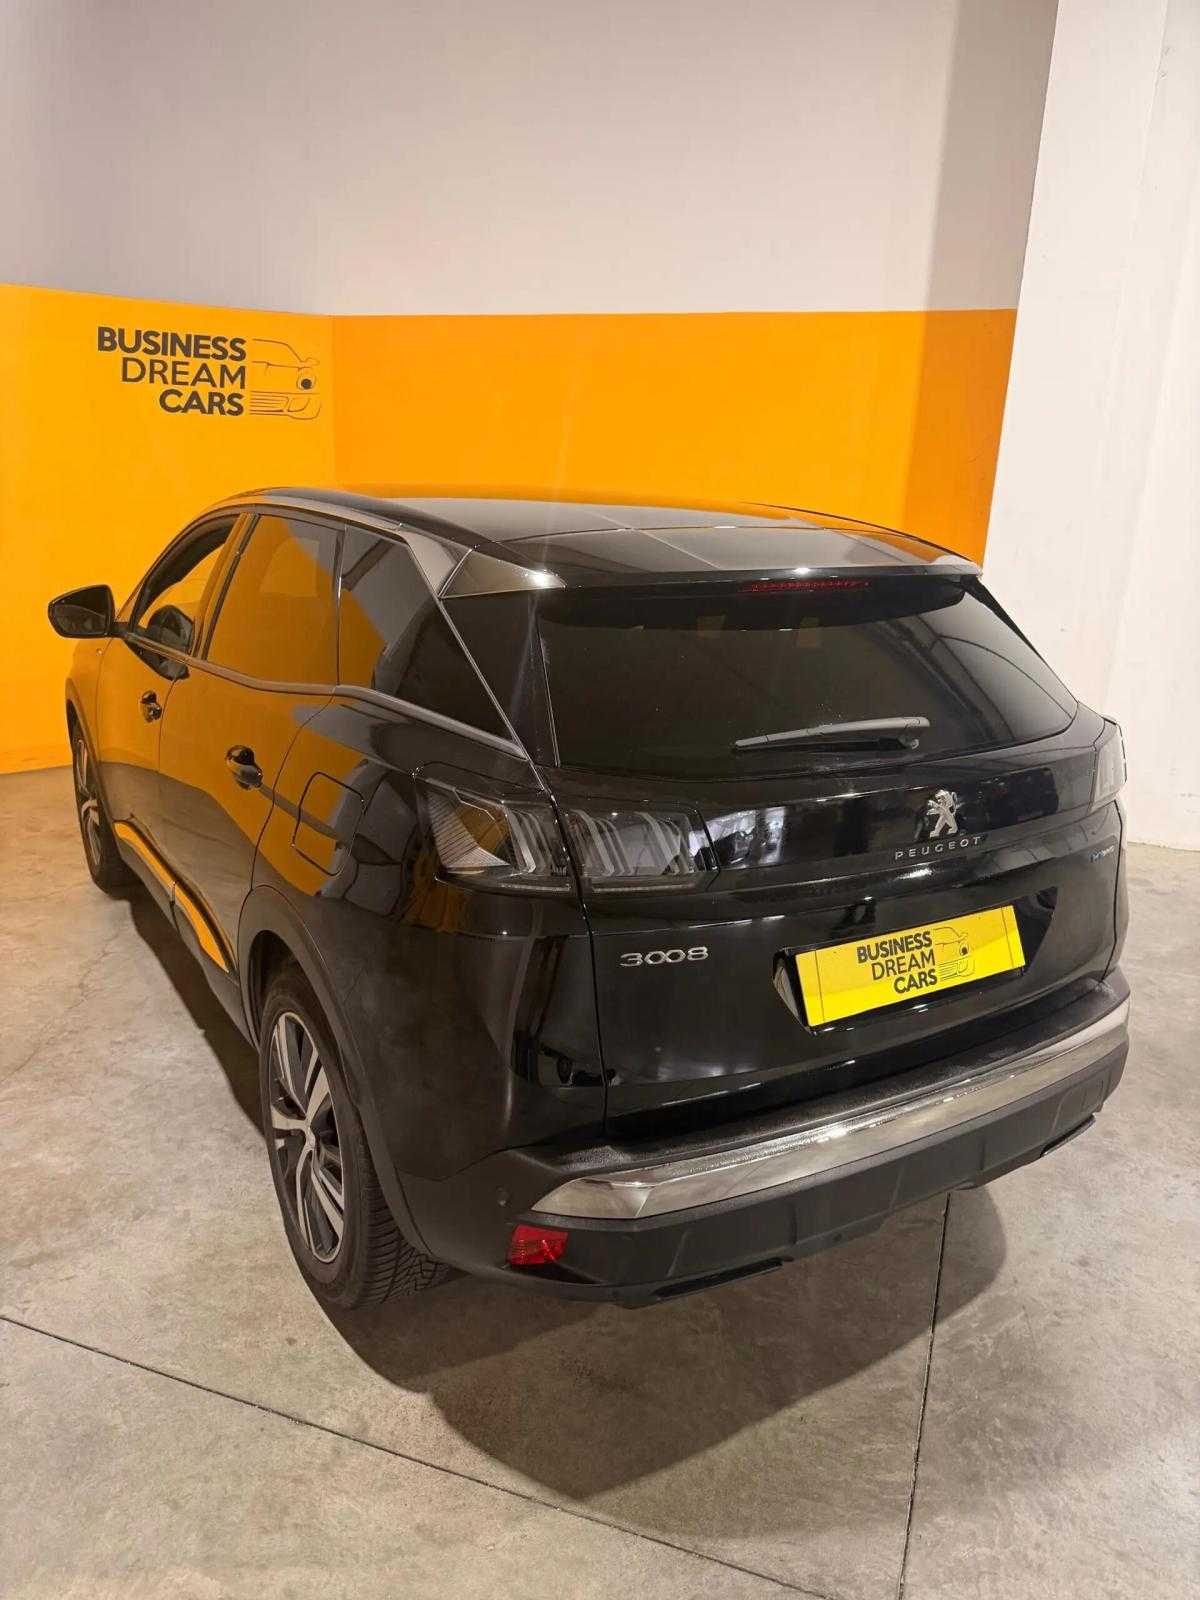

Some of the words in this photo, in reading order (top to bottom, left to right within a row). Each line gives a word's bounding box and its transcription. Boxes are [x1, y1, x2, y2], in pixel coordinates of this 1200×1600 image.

[98, 326, 247, 362] BUSINESS
[121, 357, 246, 389] DREAM
[159, 389, 244, 416] CARS
[895, 836, 981, 860] PEUGEOT
[620, 946, 708, 967] 3008
[857, 930, 933, 964] BUSINESS
[871, 949, 936, 980] DREAM
[893, 969, 938, 995] CARS
